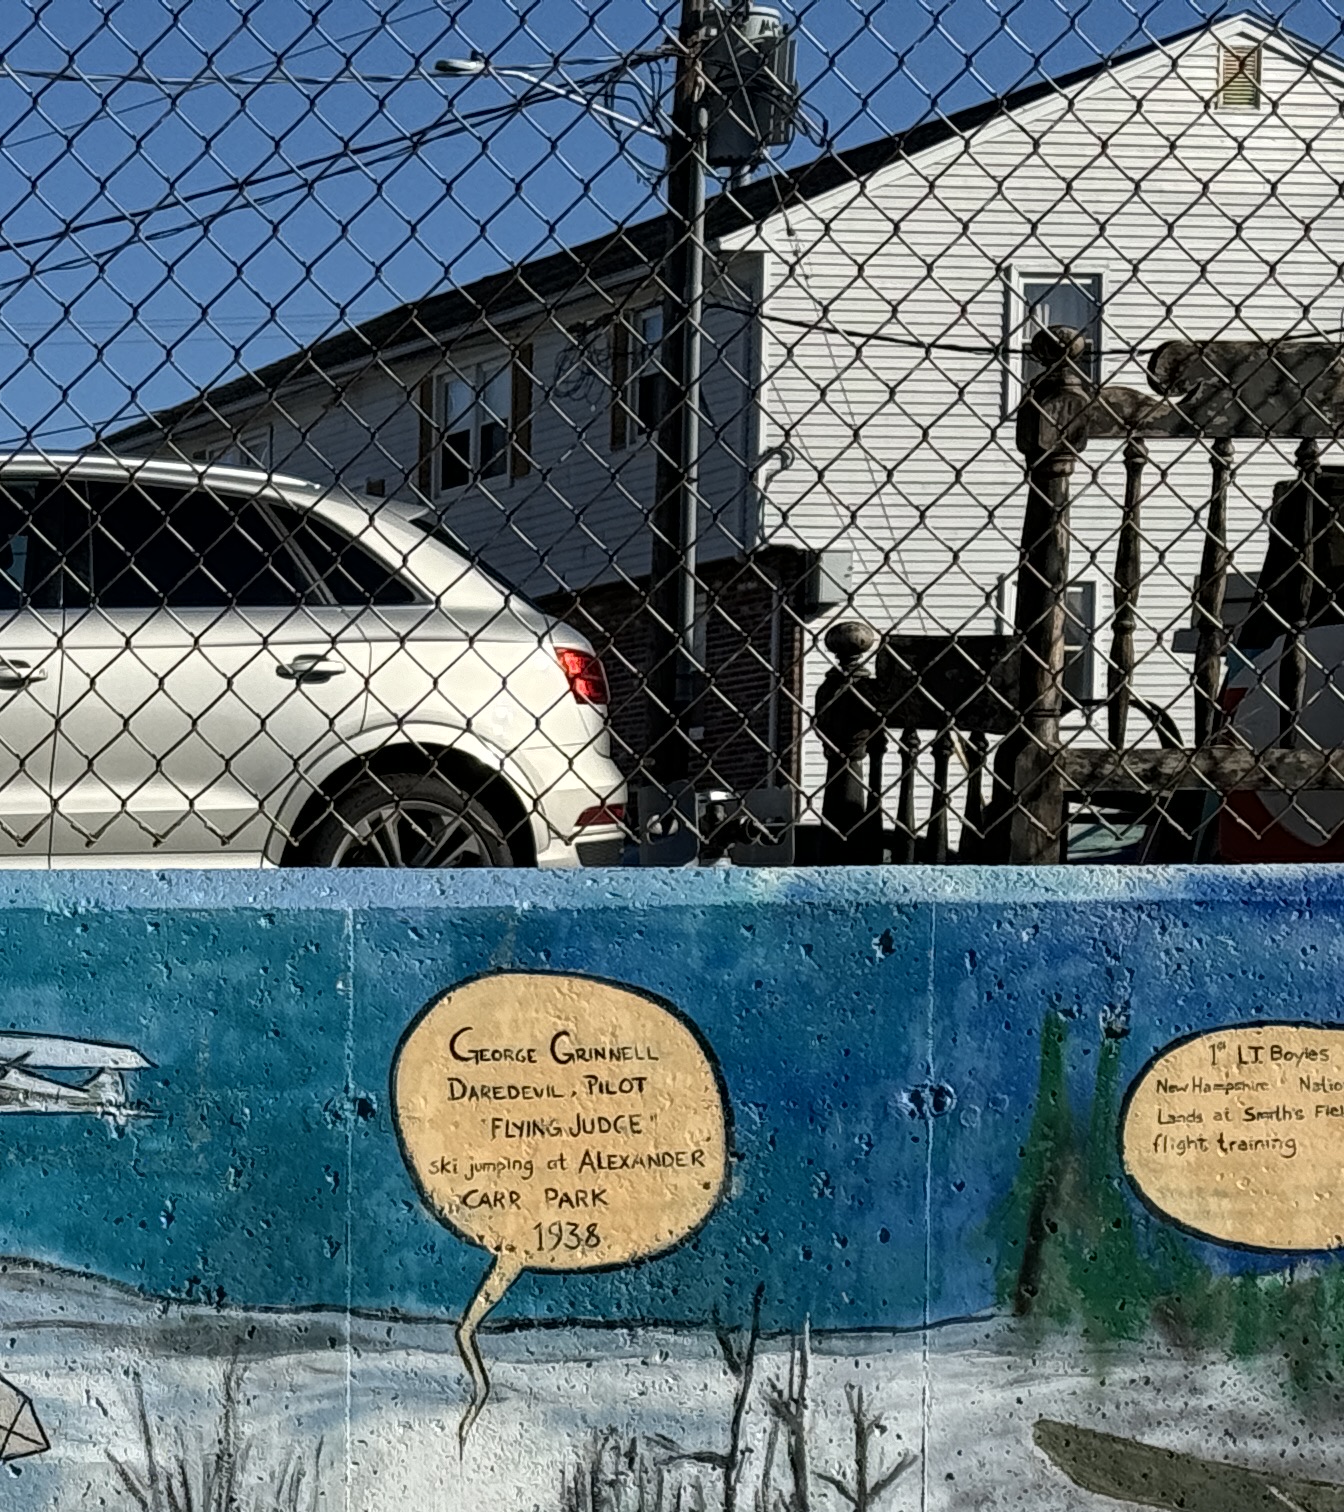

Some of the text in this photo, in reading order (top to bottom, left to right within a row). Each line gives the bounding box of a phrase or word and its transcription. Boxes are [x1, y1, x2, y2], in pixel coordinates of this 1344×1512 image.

[583, 1074, 648, 1096] PILOT
[1156, 1079, 1189, 1094] New
[1299, 1076, 1344, 1093] Natio
[1157, 1108, 1203, 1125] Lands
[1213, 1107, 1232, 1122] at
[1152, 1131, 1297, 1159] flight training
[429, 1149, 706, 1180] ski jumping at ALEXANDER
[462, 1187, 609, 1211] CARR PARK
[534, 1222, 601, 1251] 1938
